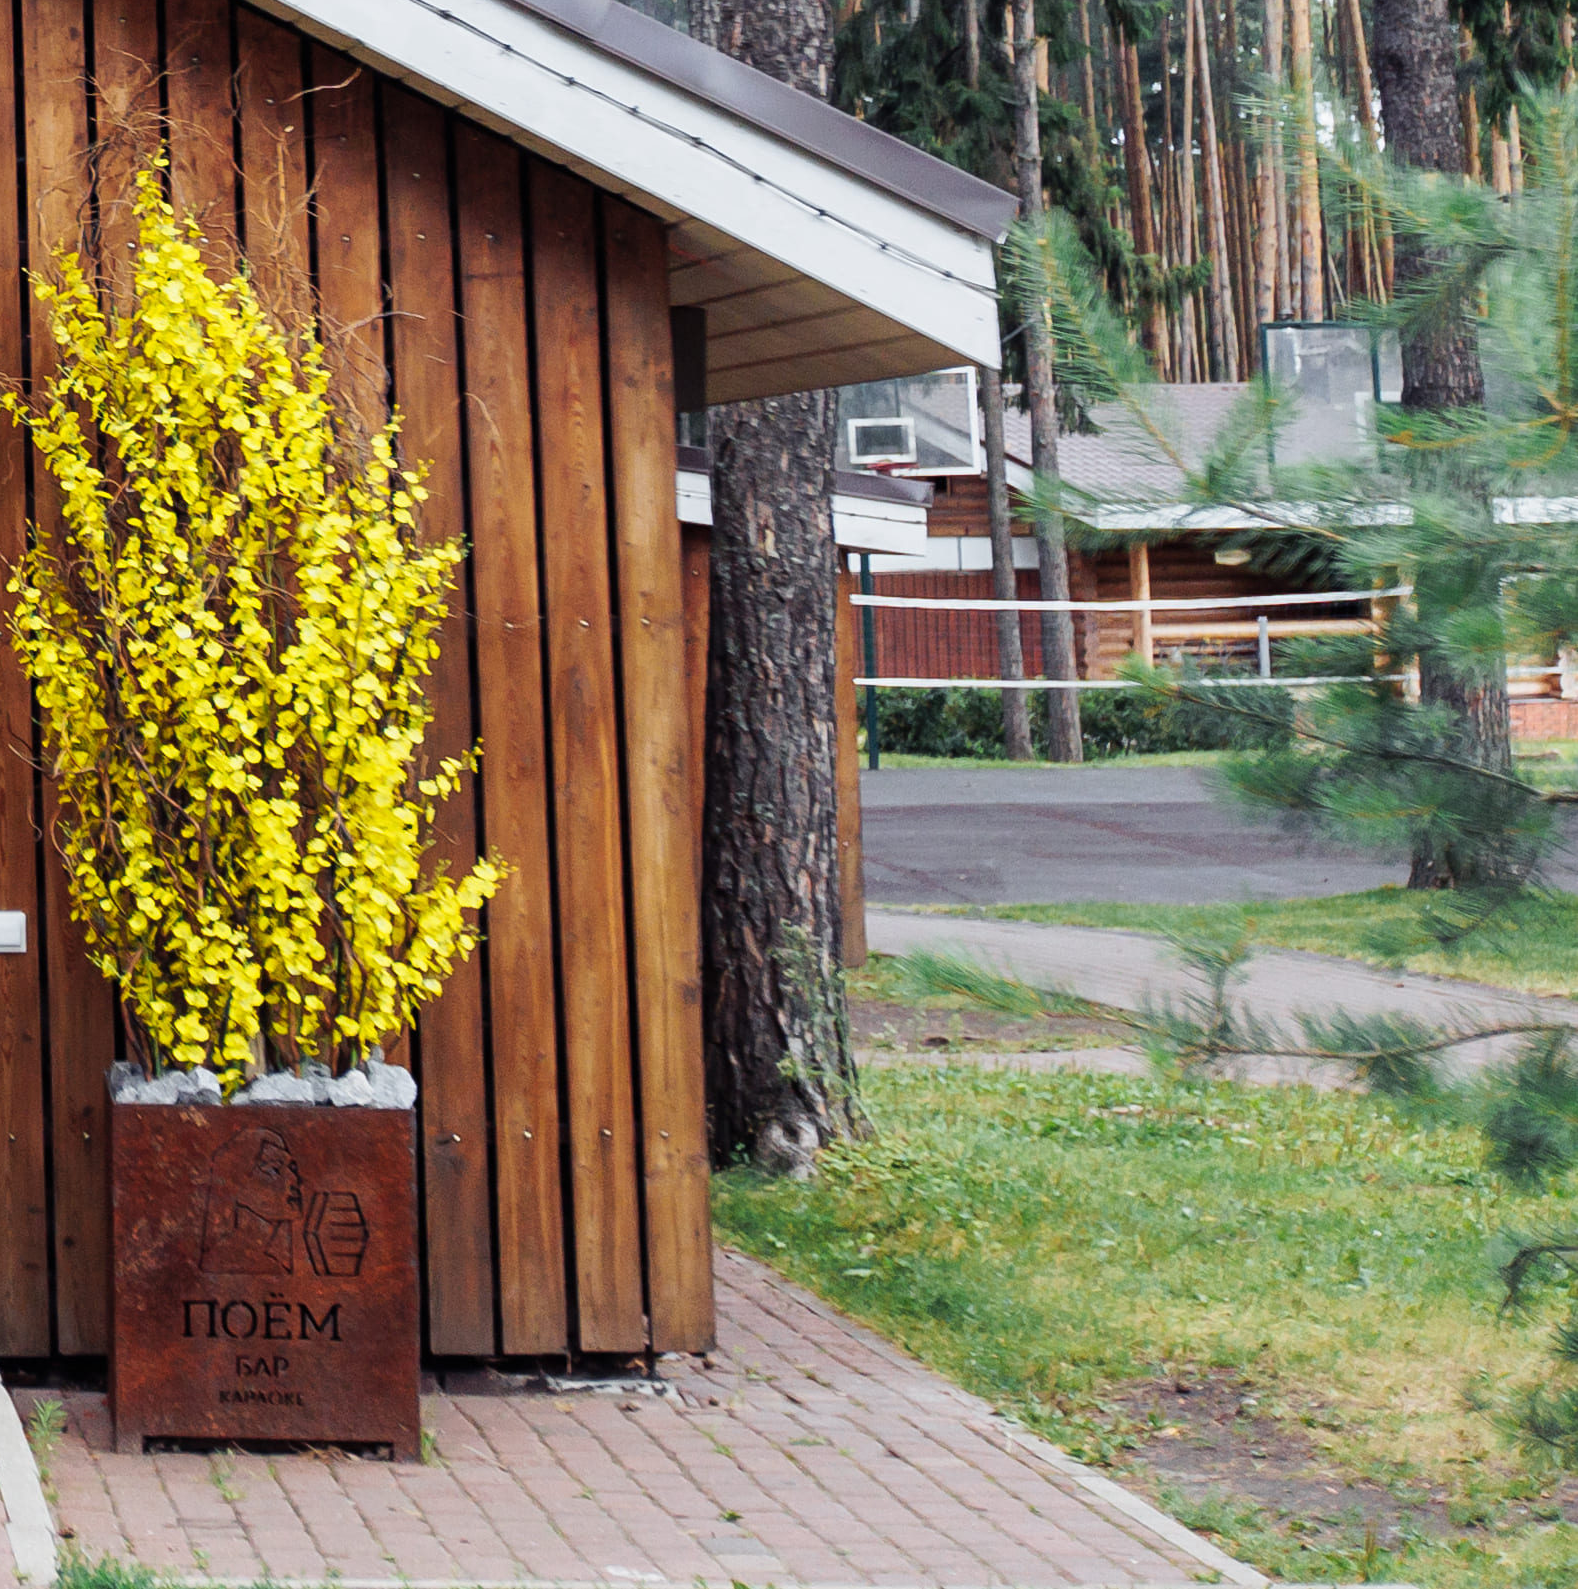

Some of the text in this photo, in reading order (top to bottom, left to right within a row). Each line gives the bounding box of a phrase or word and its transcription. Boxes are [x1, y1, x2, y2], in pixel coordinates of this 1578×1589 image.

[182, 1292, 344, 1342] ПОЁМ
[235, 1355, 290, 1378] БАР
[219, 1389, 304, 1406] КАРАОКЕ
